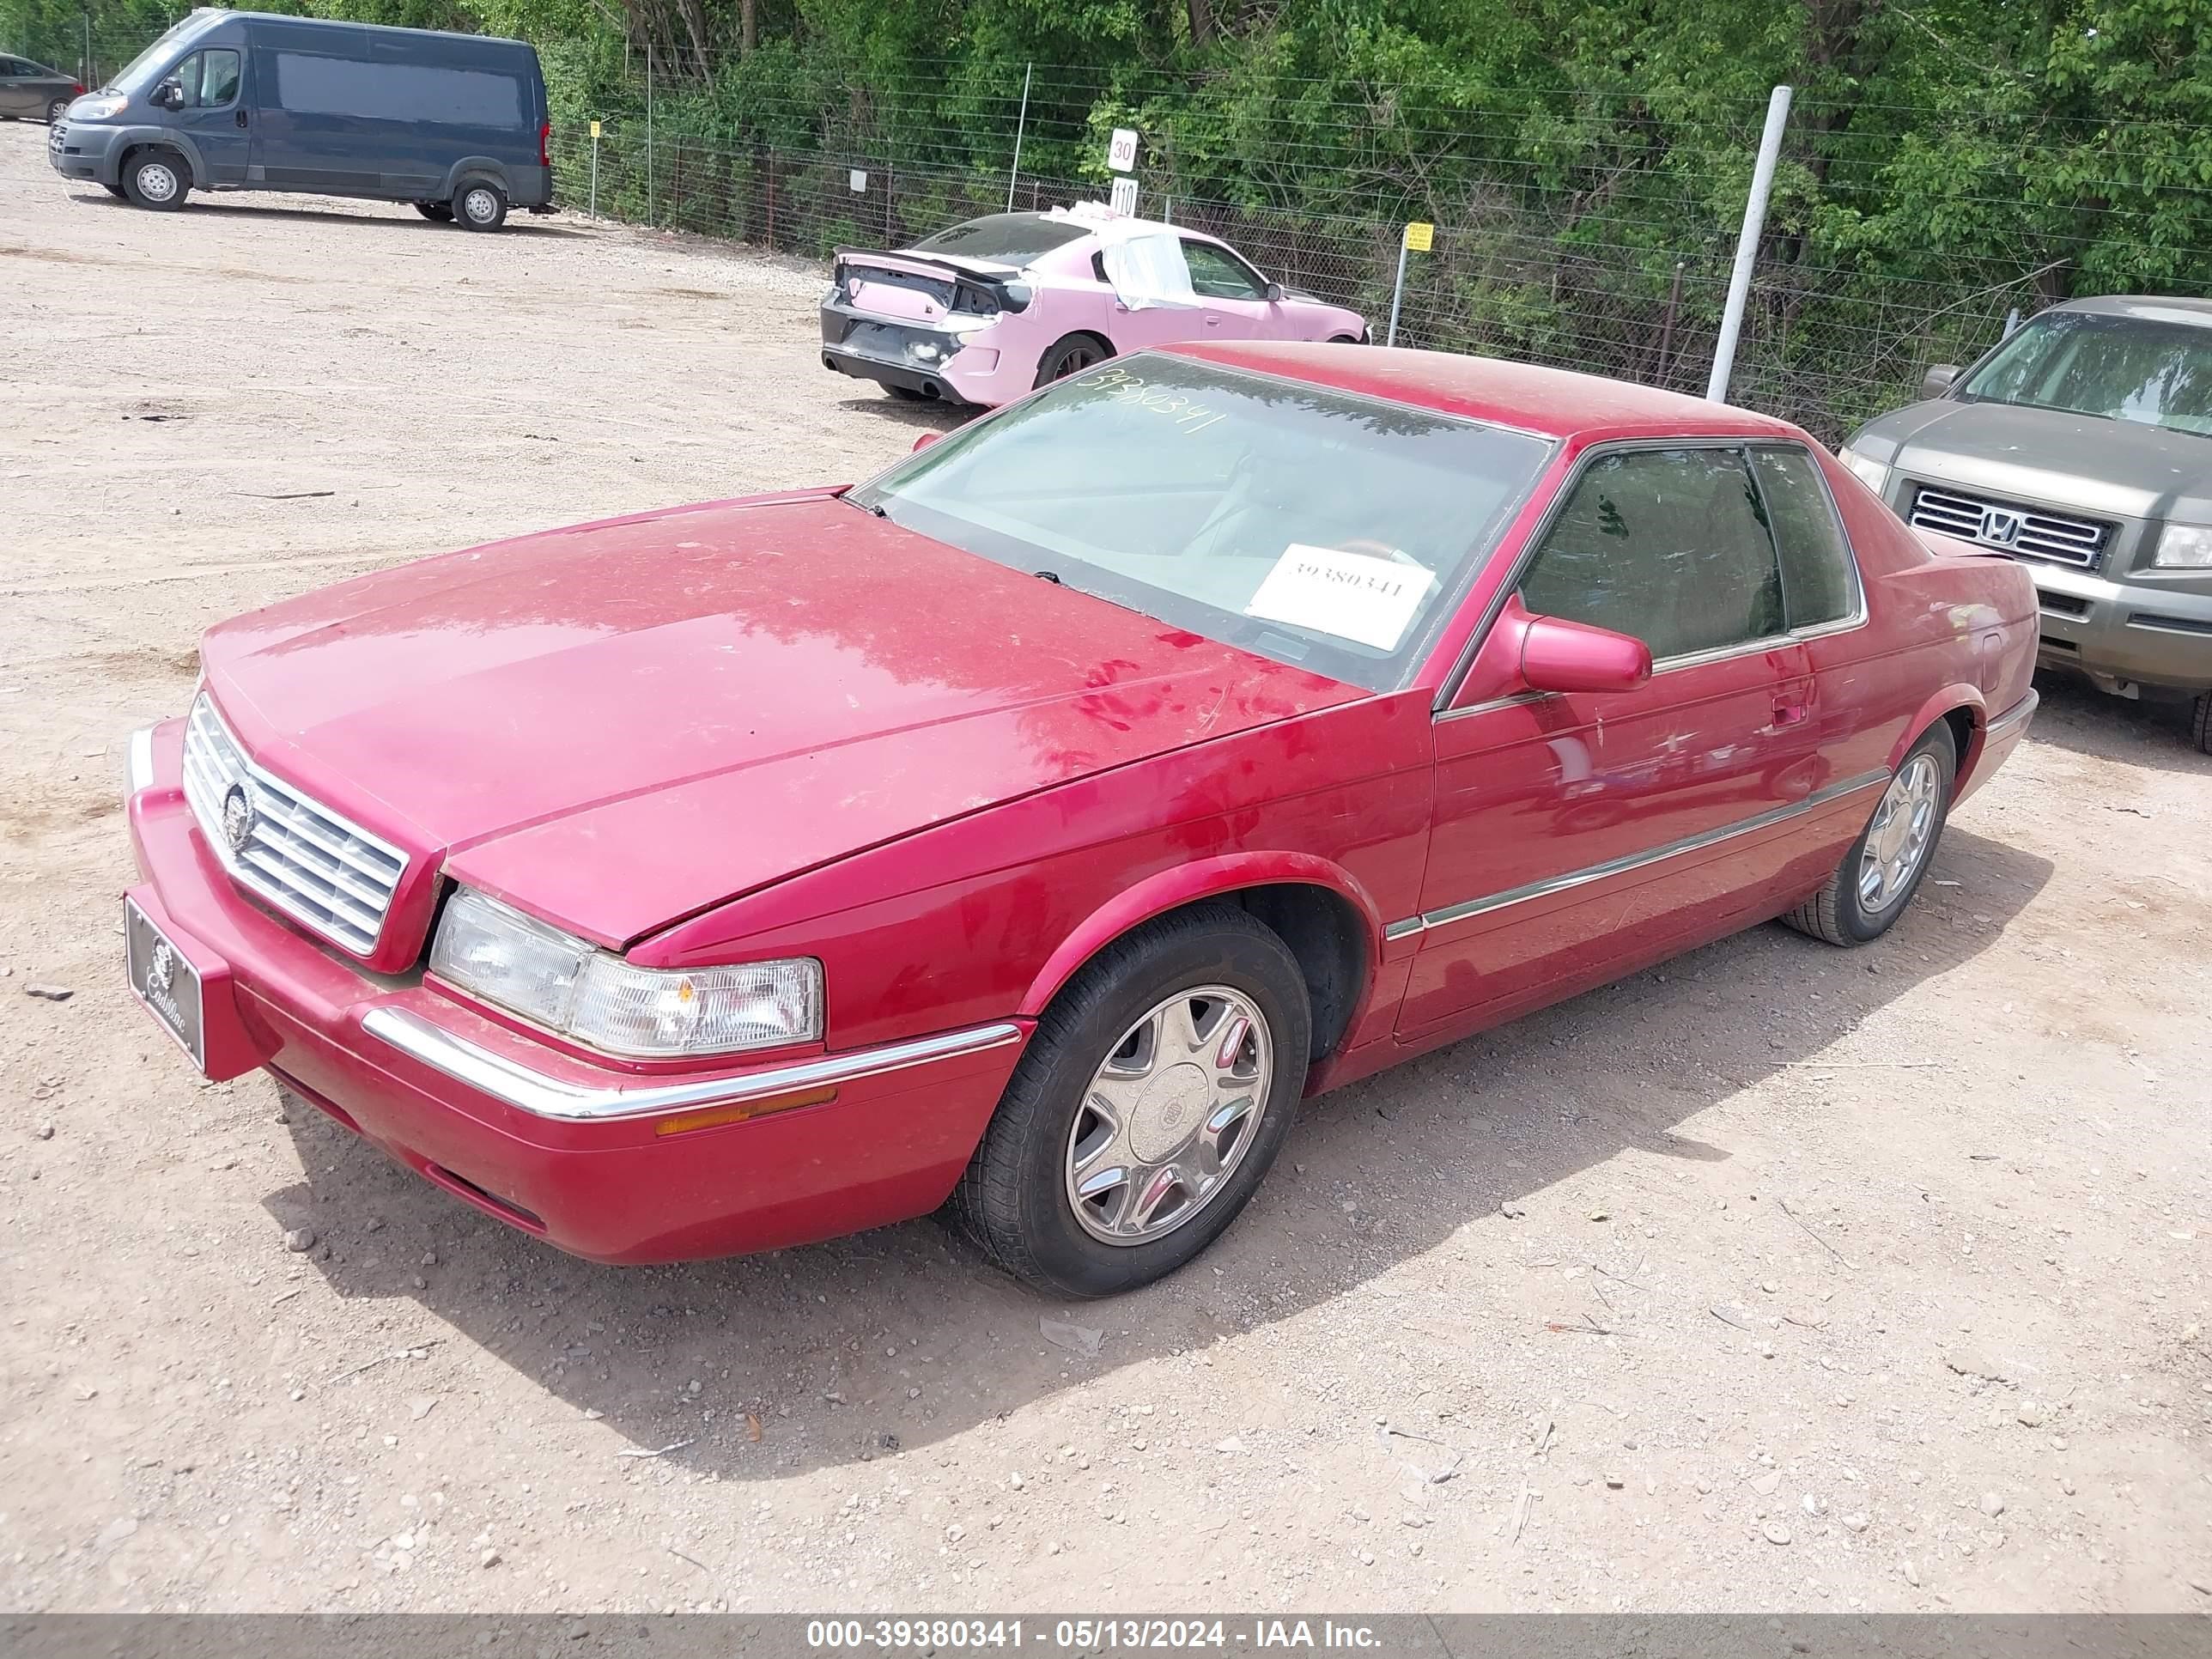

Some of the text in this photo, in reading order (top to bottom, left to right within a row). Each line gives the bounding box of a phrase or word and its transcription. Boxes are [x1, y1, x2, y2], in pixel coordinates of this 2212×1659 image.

[1114, 141, 1132, 161] 30
[1115, 183, 1134, 216] 110
[1076, 368, 1227, 434] 39380341
[1295, 562, 1402, 597] 39380341
[145, 966, 186, 1034] Cadillac
